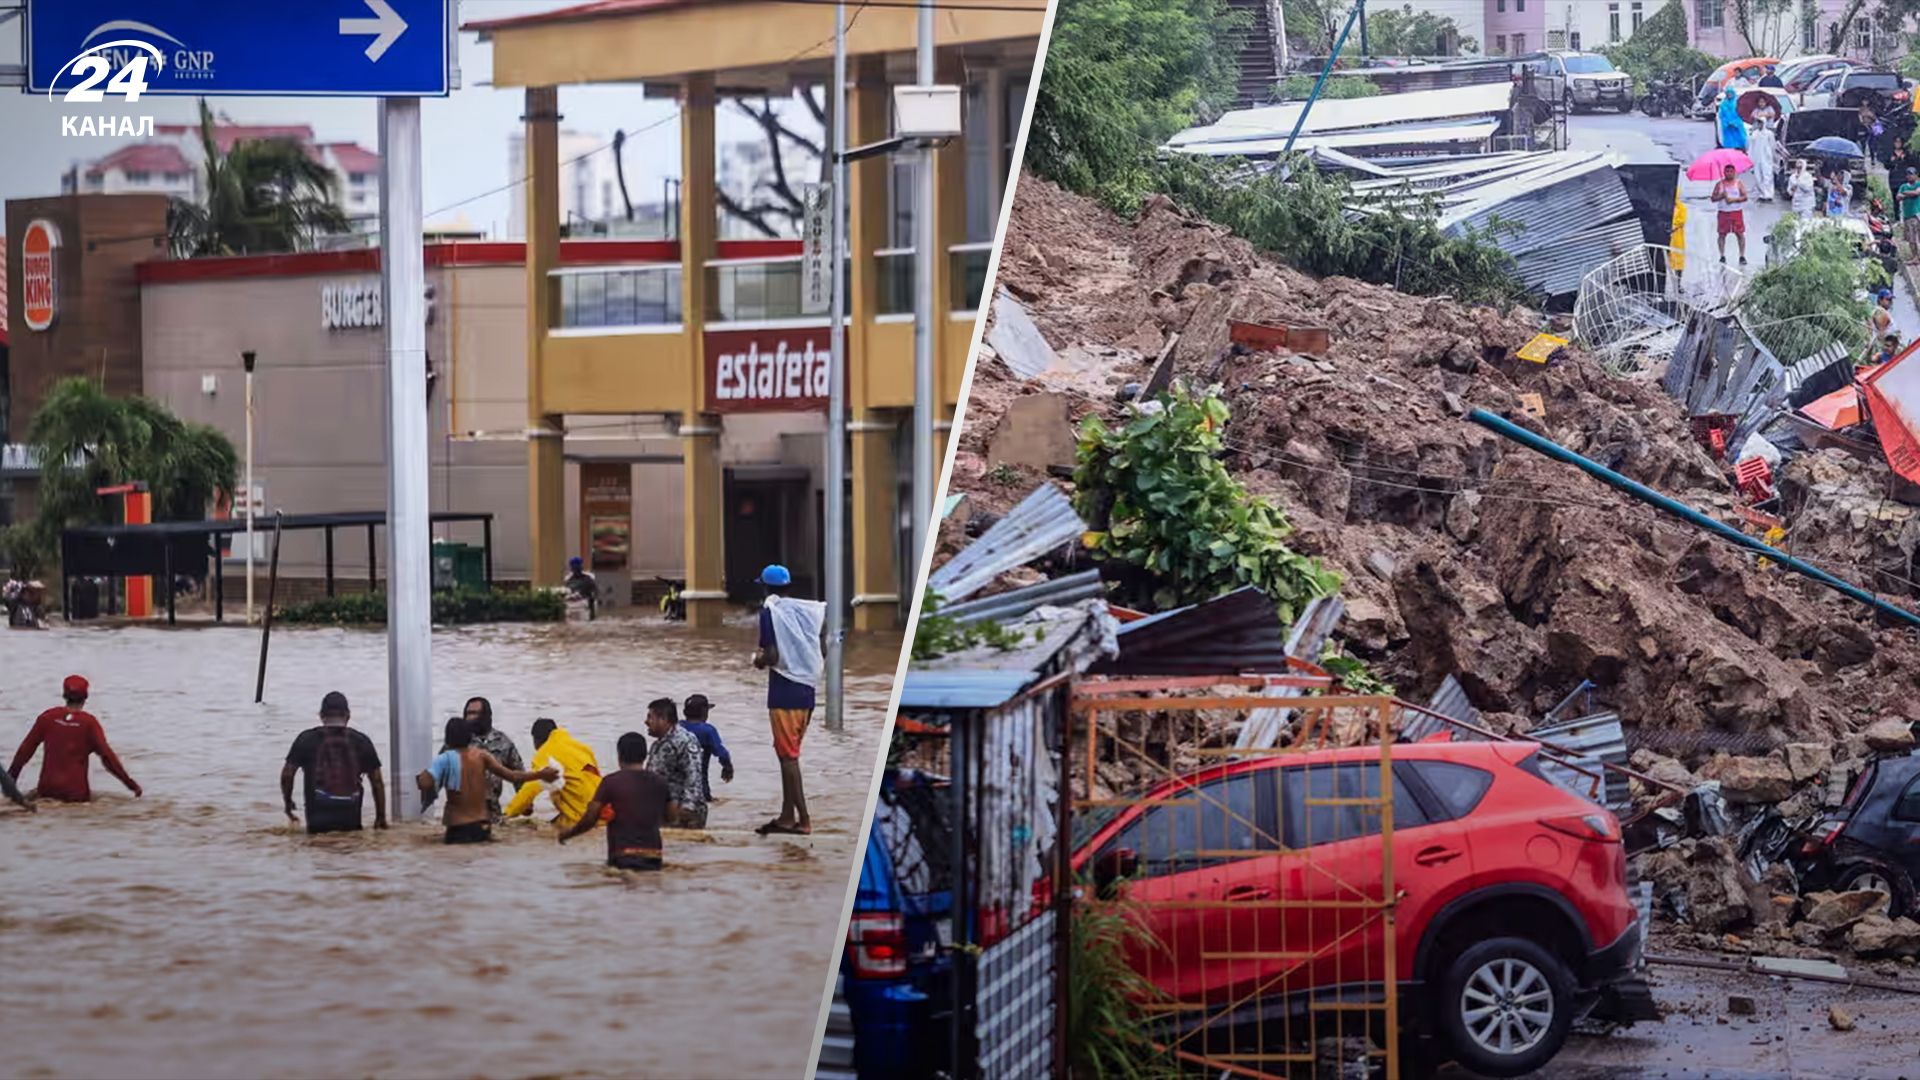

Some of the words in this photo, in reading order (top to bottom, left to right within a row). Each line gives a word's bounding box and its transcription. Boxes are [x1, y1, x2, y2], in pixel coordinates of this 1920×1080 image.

[174, 50, 214, 71] GNP
[25, 278, 52, 307] KING
[716, 340, 831, 399] estafeta
